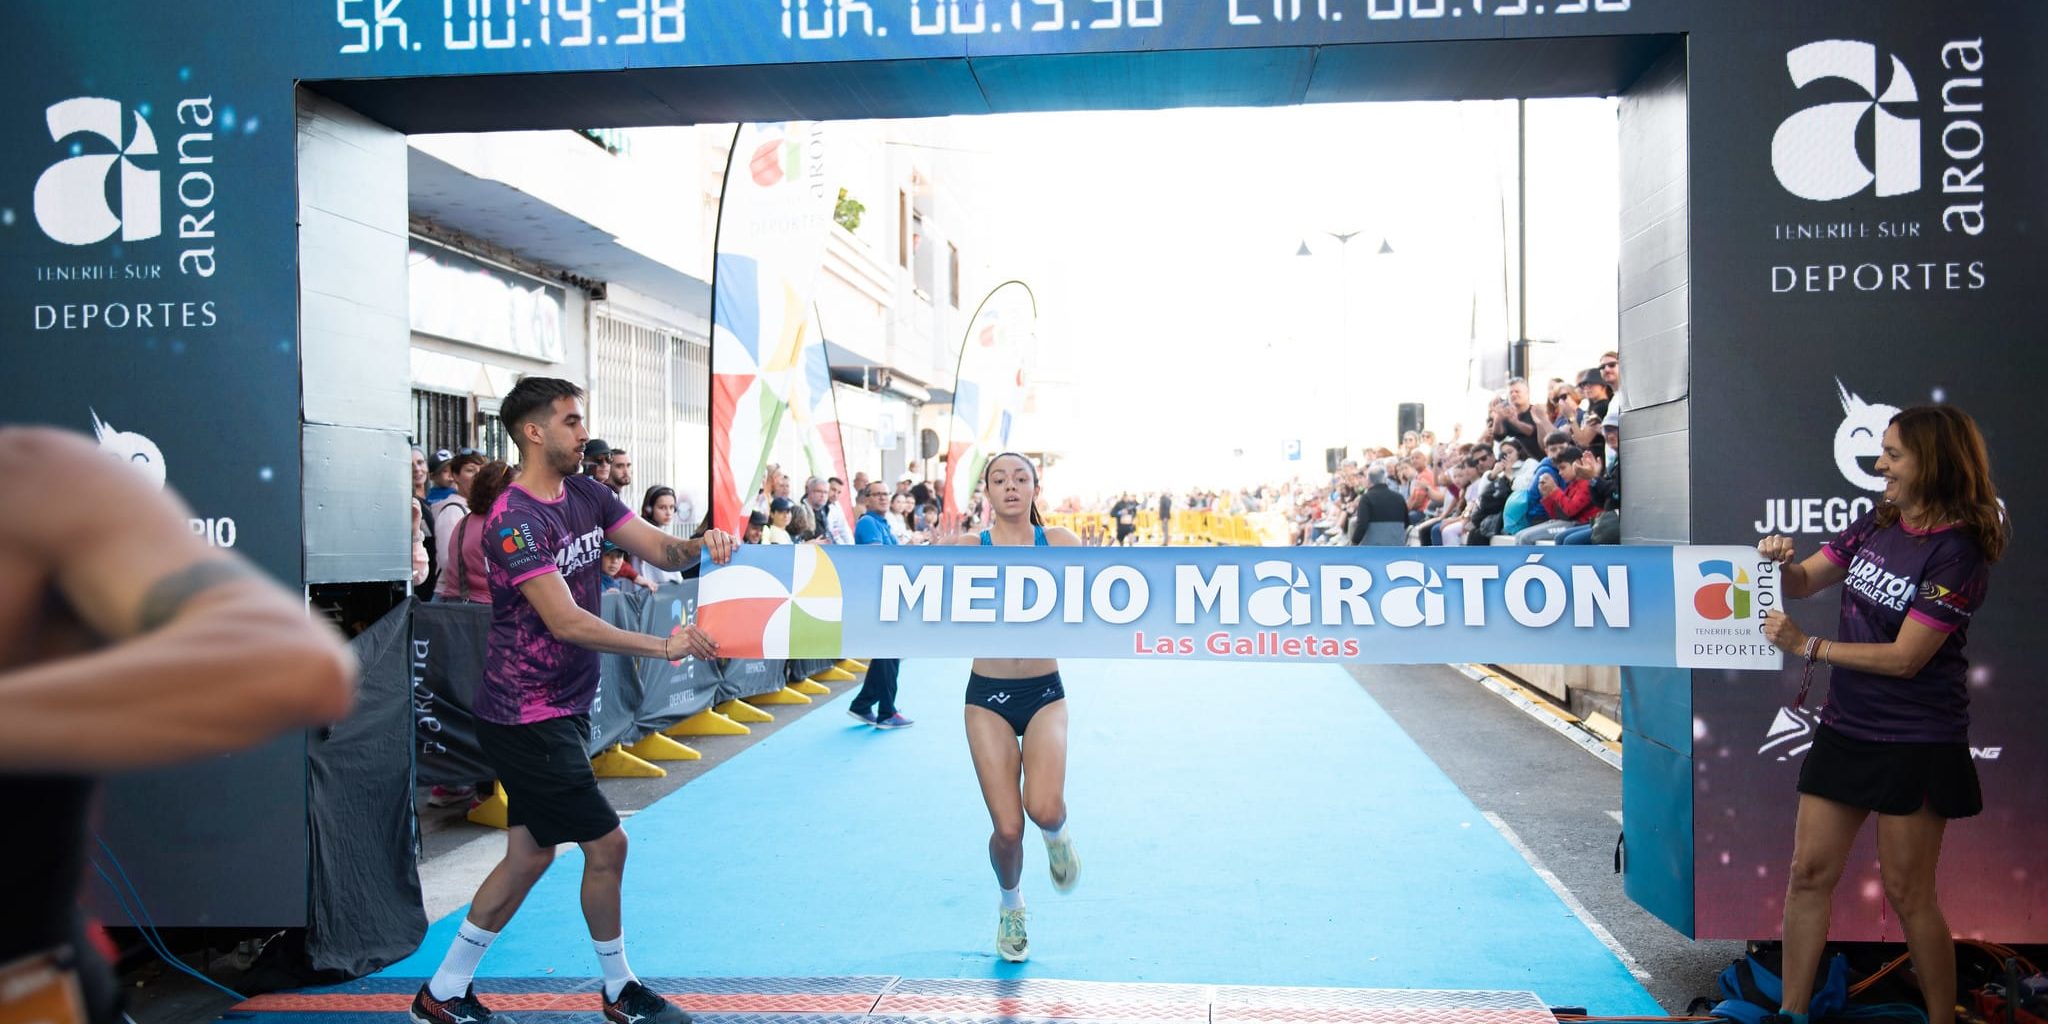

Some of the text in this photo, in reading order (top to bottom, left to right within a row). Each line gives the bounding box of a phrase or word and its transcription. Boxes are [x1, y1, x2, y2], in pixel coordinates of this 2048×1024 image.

[1877, 221, 1921, 238] SUR
[124, 264, 161, 279] SUR
[1771, 261, 1986, 292] DEPORTES
[34, 301, 217, 330] DEPORTES
[879, 563, 1150, 625] MEDIO
[1852, 578, 1907, 612] GALLETAS
[1135, 631, 1360, 657] Las Galletas
[1695, 628, 1751, 636] TENERIFE SUR
[1694, 643, 1776, 656] DEPORTES
